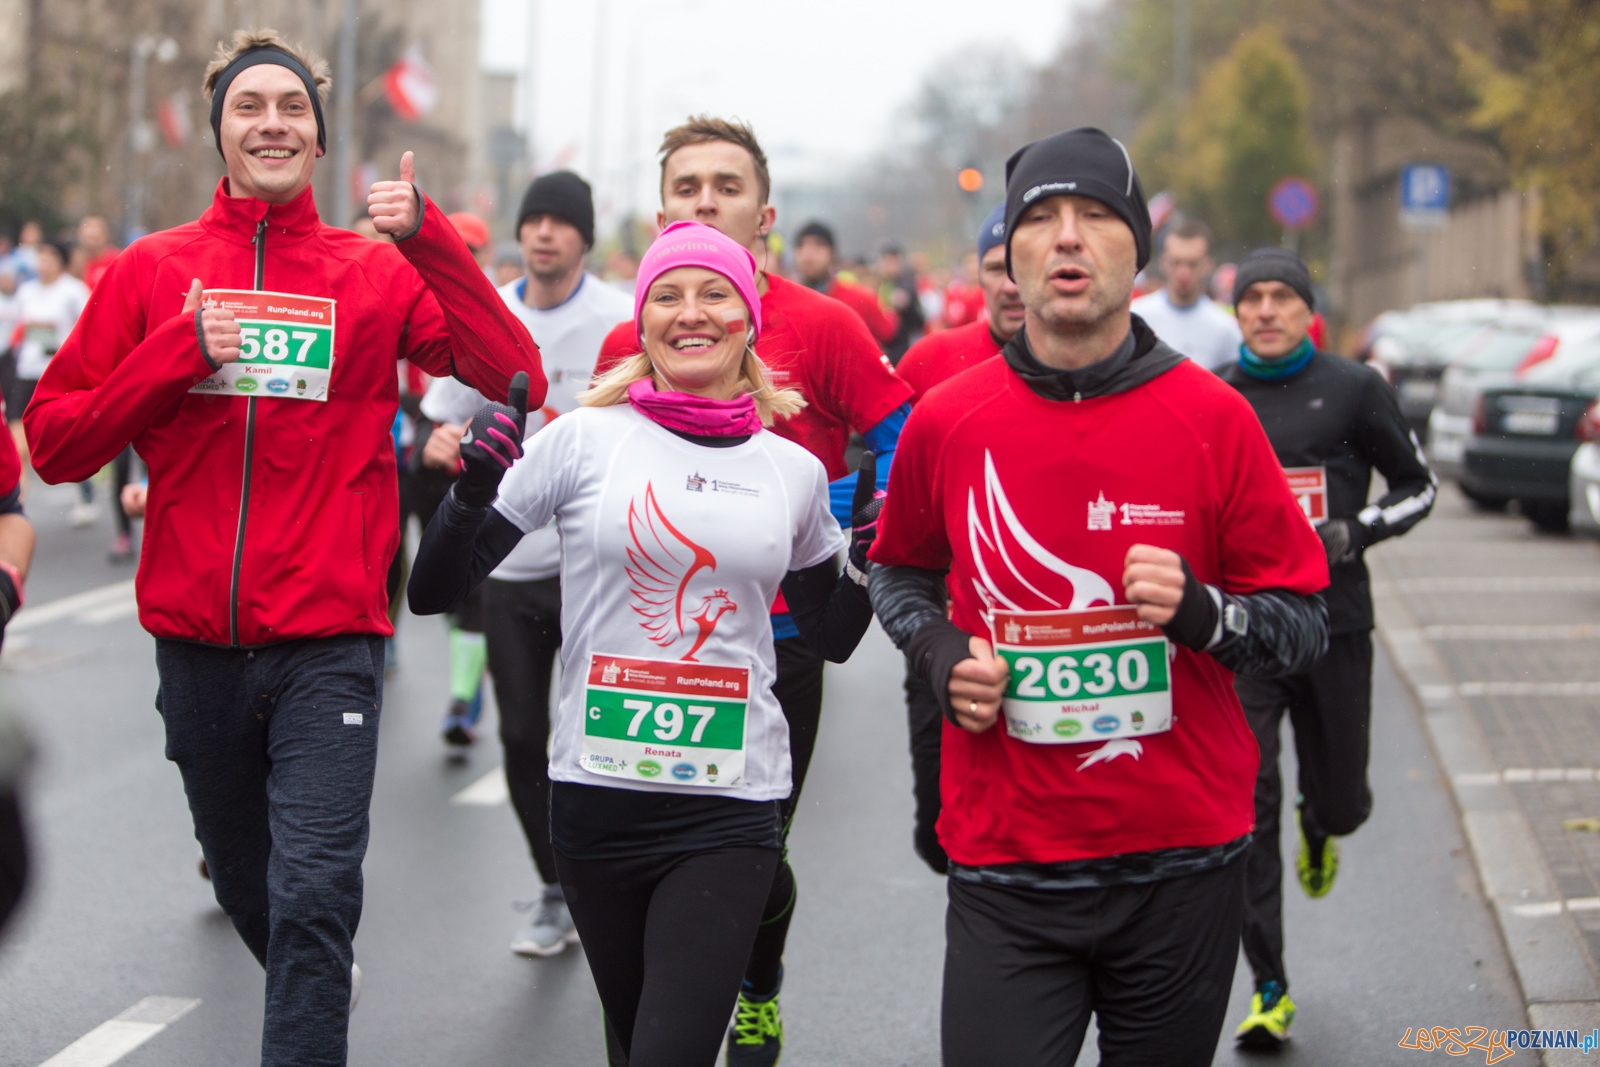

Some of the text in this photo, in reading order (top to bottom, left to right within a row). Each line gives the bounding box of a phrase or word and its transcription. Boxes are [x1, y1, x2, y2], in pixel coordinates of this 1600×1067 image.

[267, 305, 324, 319] RunPoland.org
[245, 366, 272, 374] Kamil
[1119, 502, 1133, 525] 1
[1082, 620, 1154, 635] RunPoland.org
[623, 668, 630, 682] 1
[1014, 649, 1150, 698] 2630
[676, 676, 740, 691] RunPoland.org
[588, 698, 716, 743] C 797
[590, 754, 614, 764] GRUPA
[644, 747, 682, 758] Renata
[588, 761, 618, 772] LUXMED
